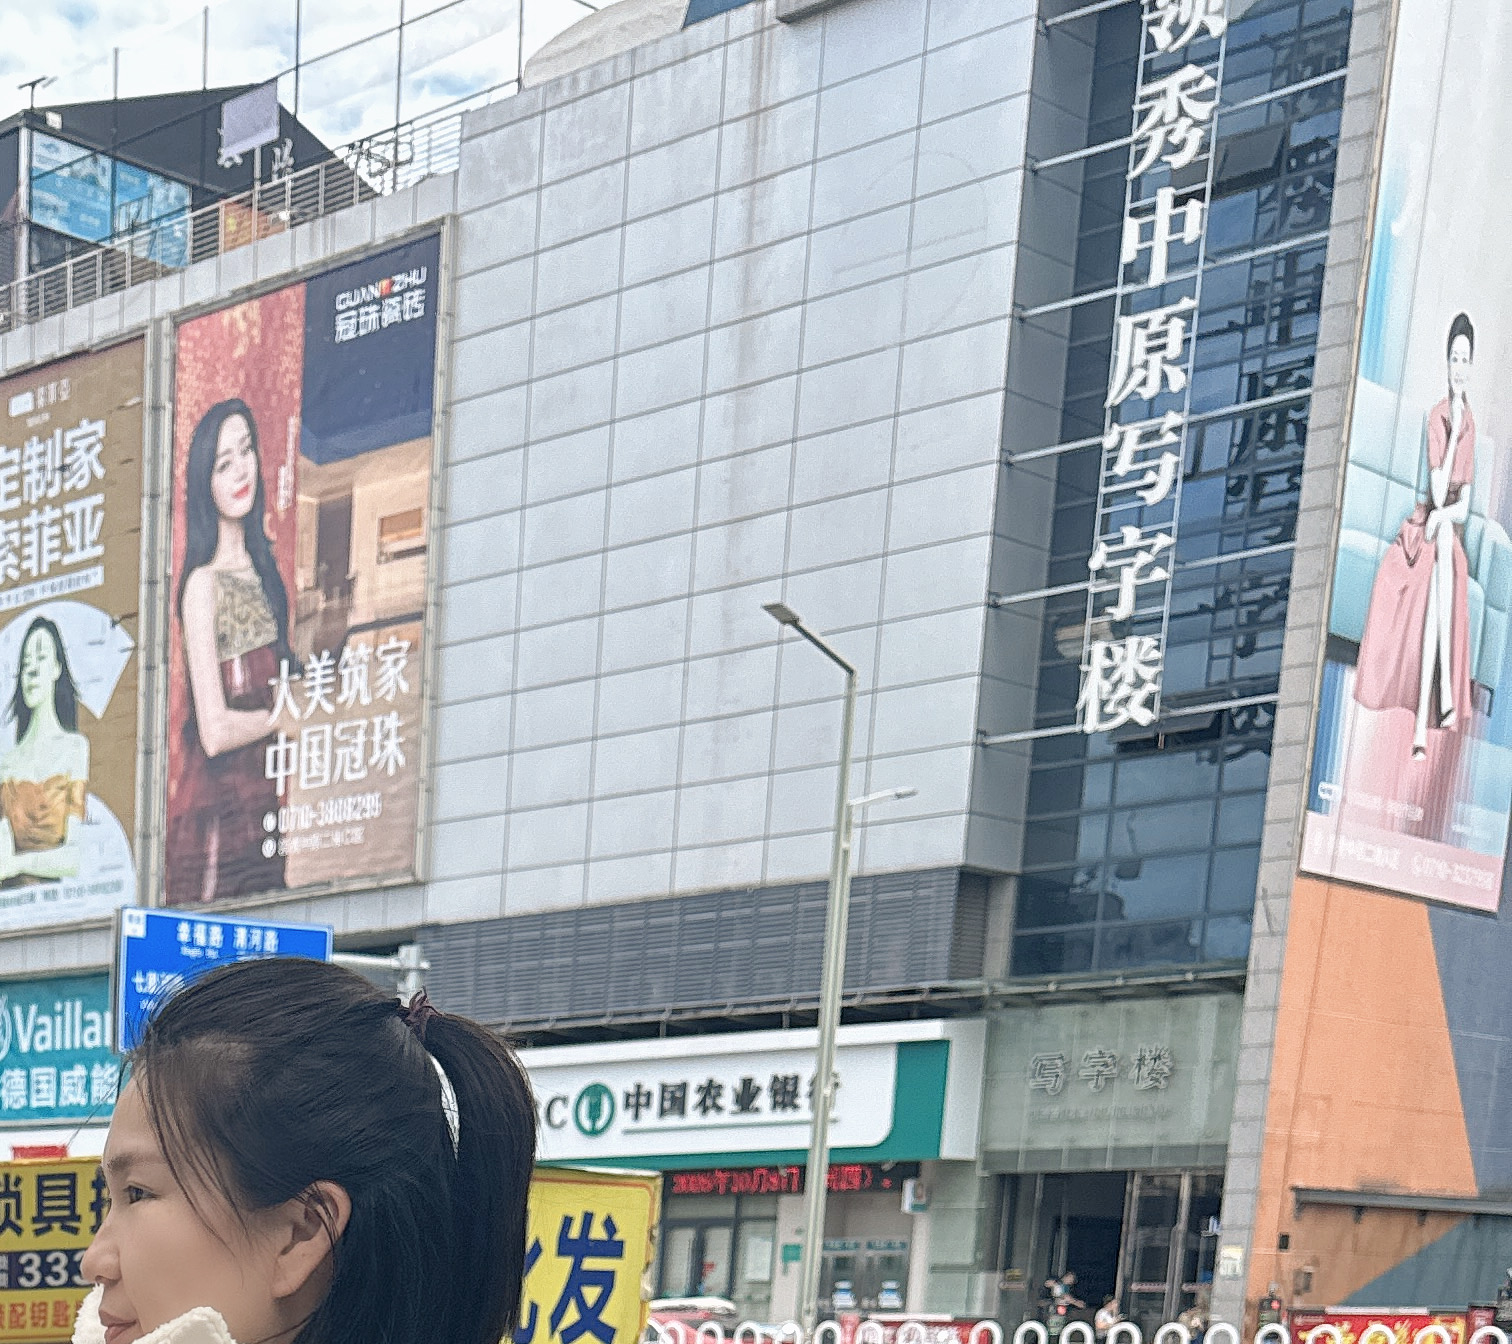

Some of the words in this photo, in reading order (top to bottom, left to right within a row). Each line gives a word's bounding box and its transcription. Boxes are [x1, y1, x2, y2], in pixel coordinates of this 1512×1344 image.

[265, 635, 412, 727] 大美筑家
[264, 710, 407, 797] 中国冠珠
[0, 1062, 119, 1111] 德国威能
[1029, 1045, 1174, 1096] 写字楼
